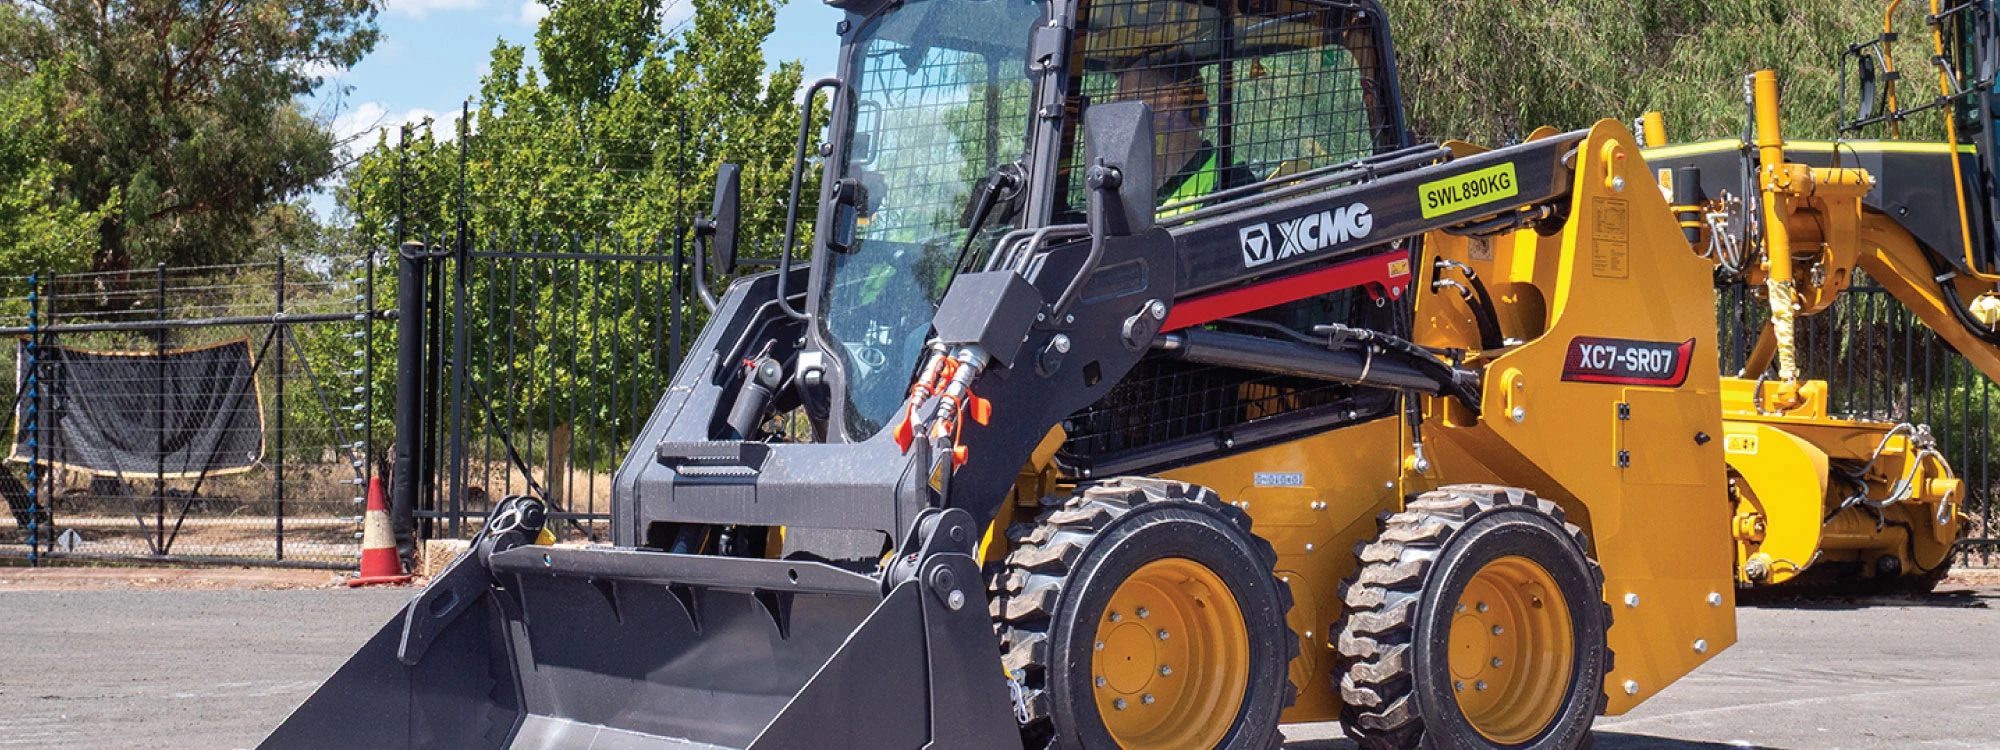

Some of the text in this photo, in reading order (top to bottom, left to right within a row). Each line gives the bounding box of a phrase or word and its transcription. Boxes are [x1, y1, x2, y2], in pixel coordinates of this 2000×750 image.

[1427, 171, 1512, 210] SWL890KG
[1276, 202, 1373, 261] XCMG
[1579, 343, 1673, 374] XC7-SR07
